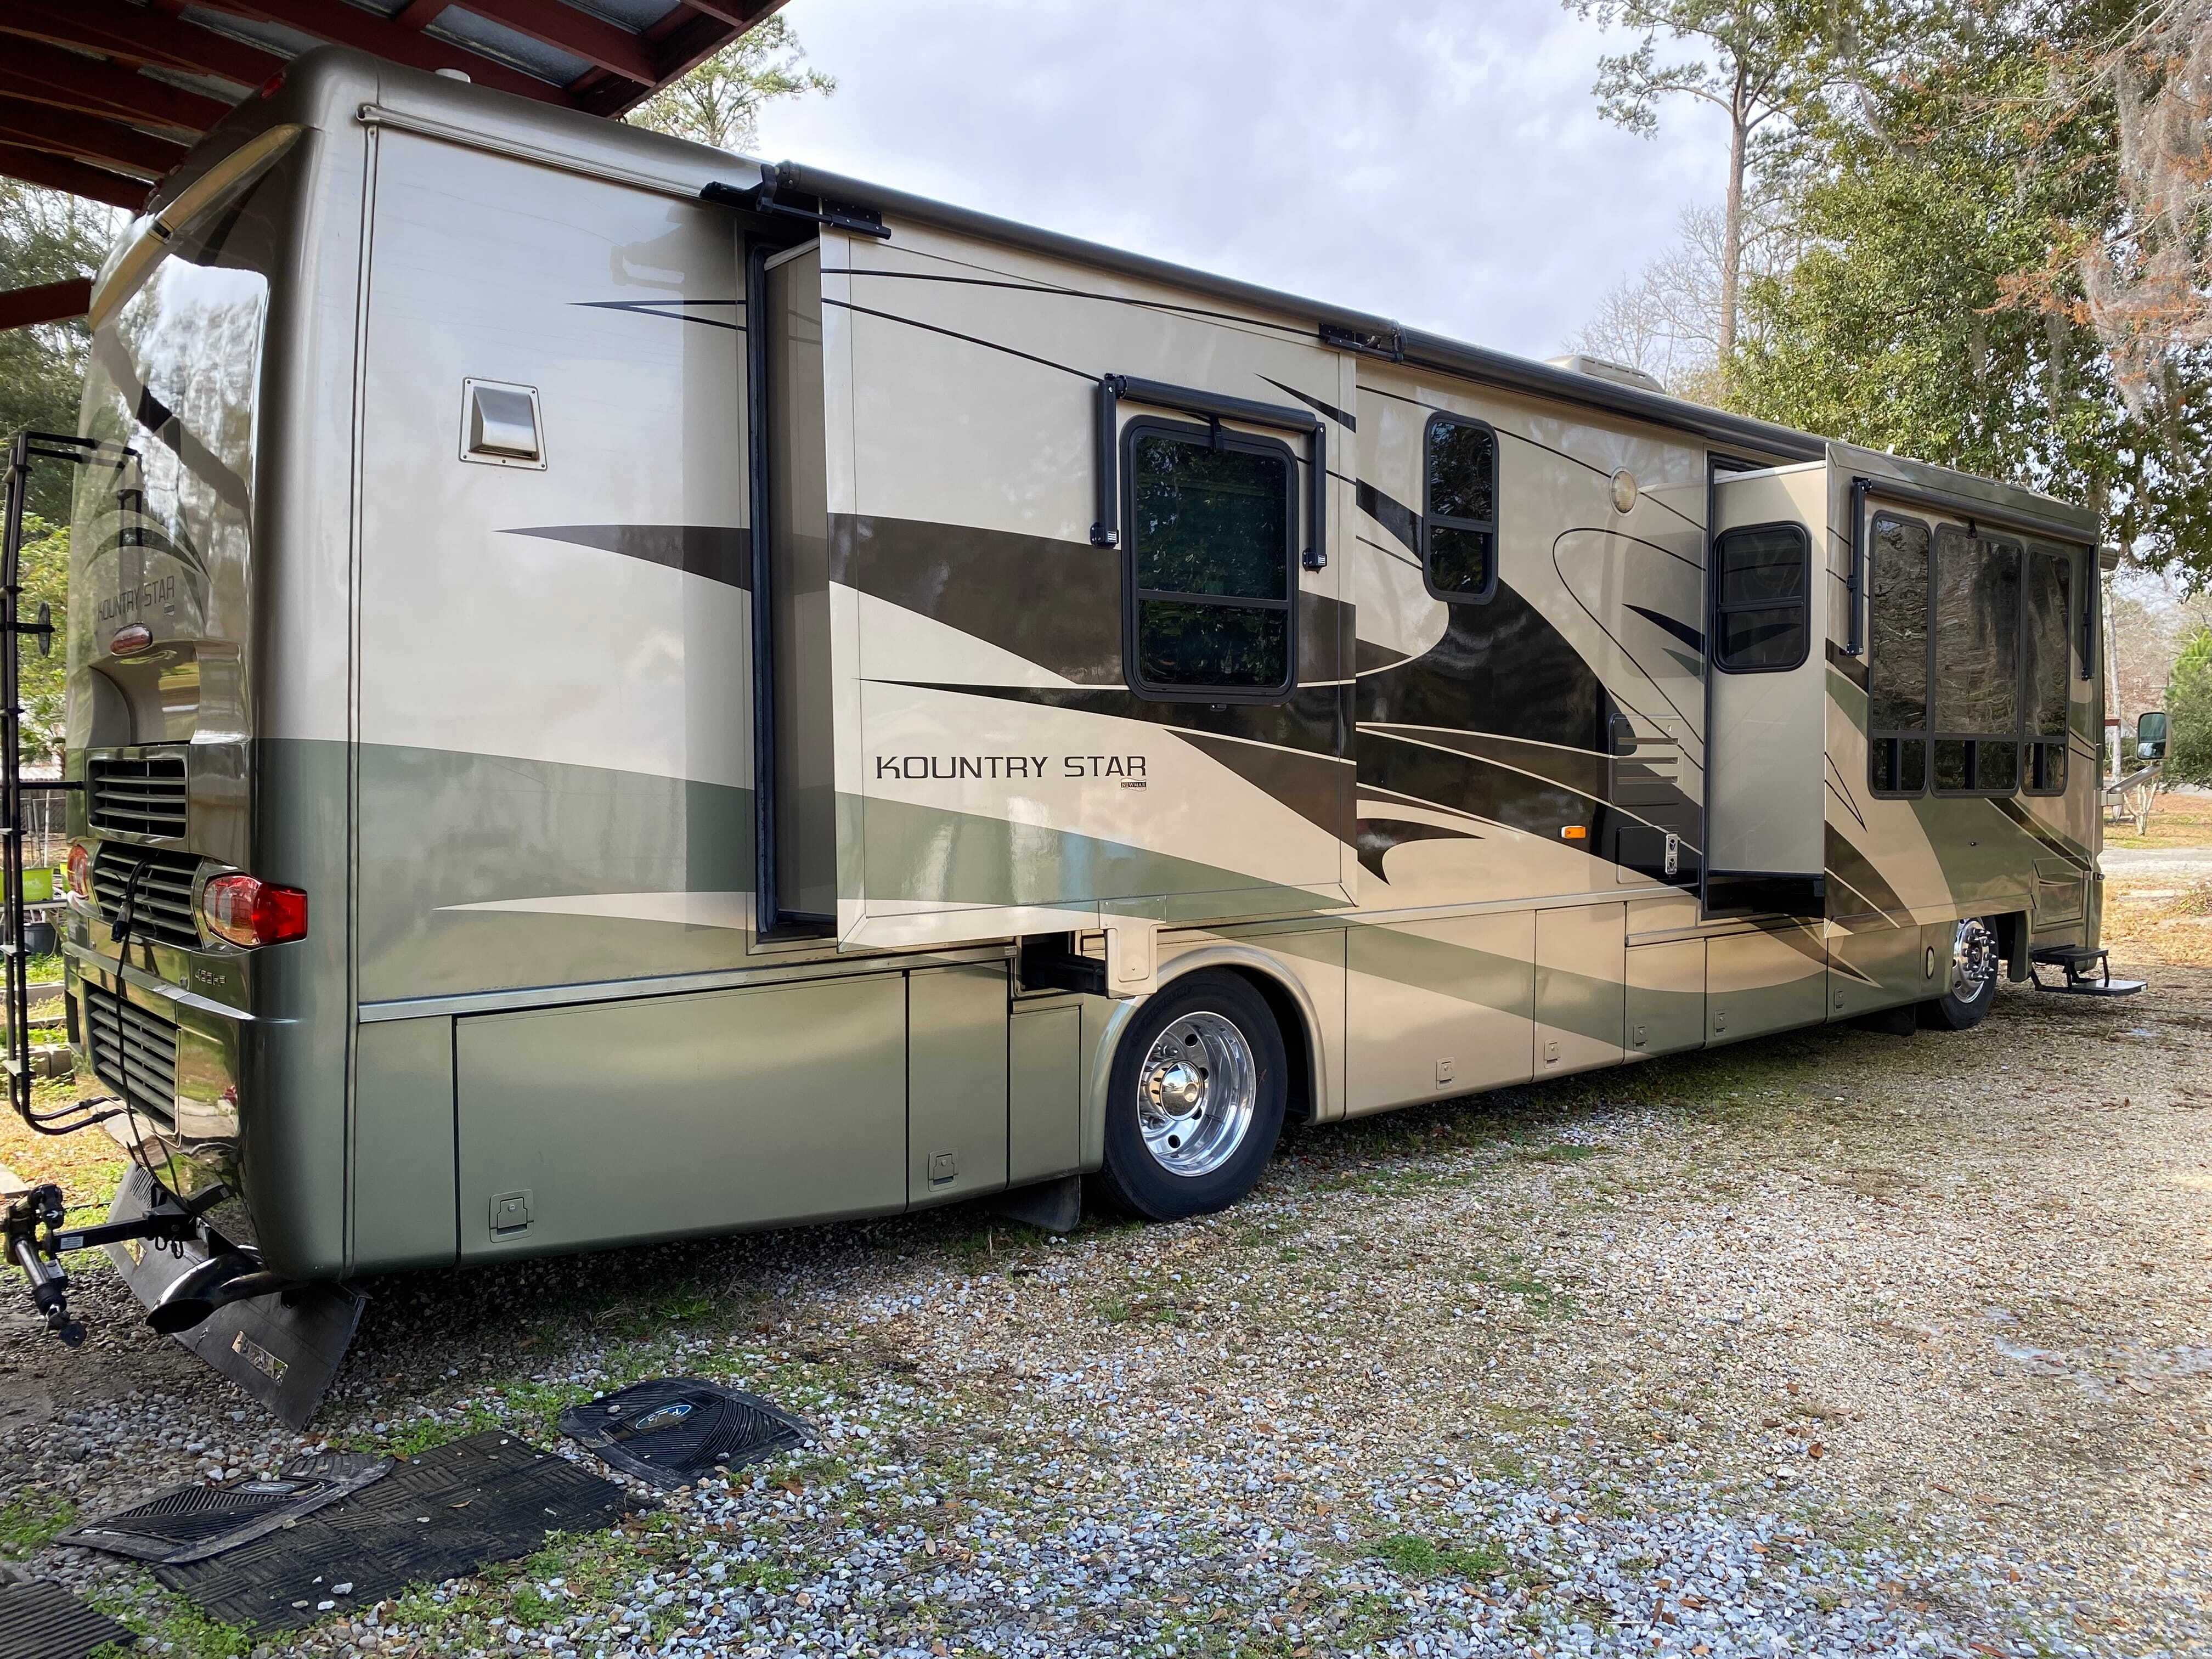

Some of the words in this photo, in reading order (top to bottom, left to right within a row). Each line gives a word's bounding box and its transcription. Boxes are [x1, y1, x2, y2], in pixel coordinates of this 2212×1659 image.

[98, 588, 140, 622] KOUNTRY
[144, 575, 174, 607] STAR
[876, 757, 1048, 779] KOUNTRY
[1064, 756, 1147, 777] STAR
